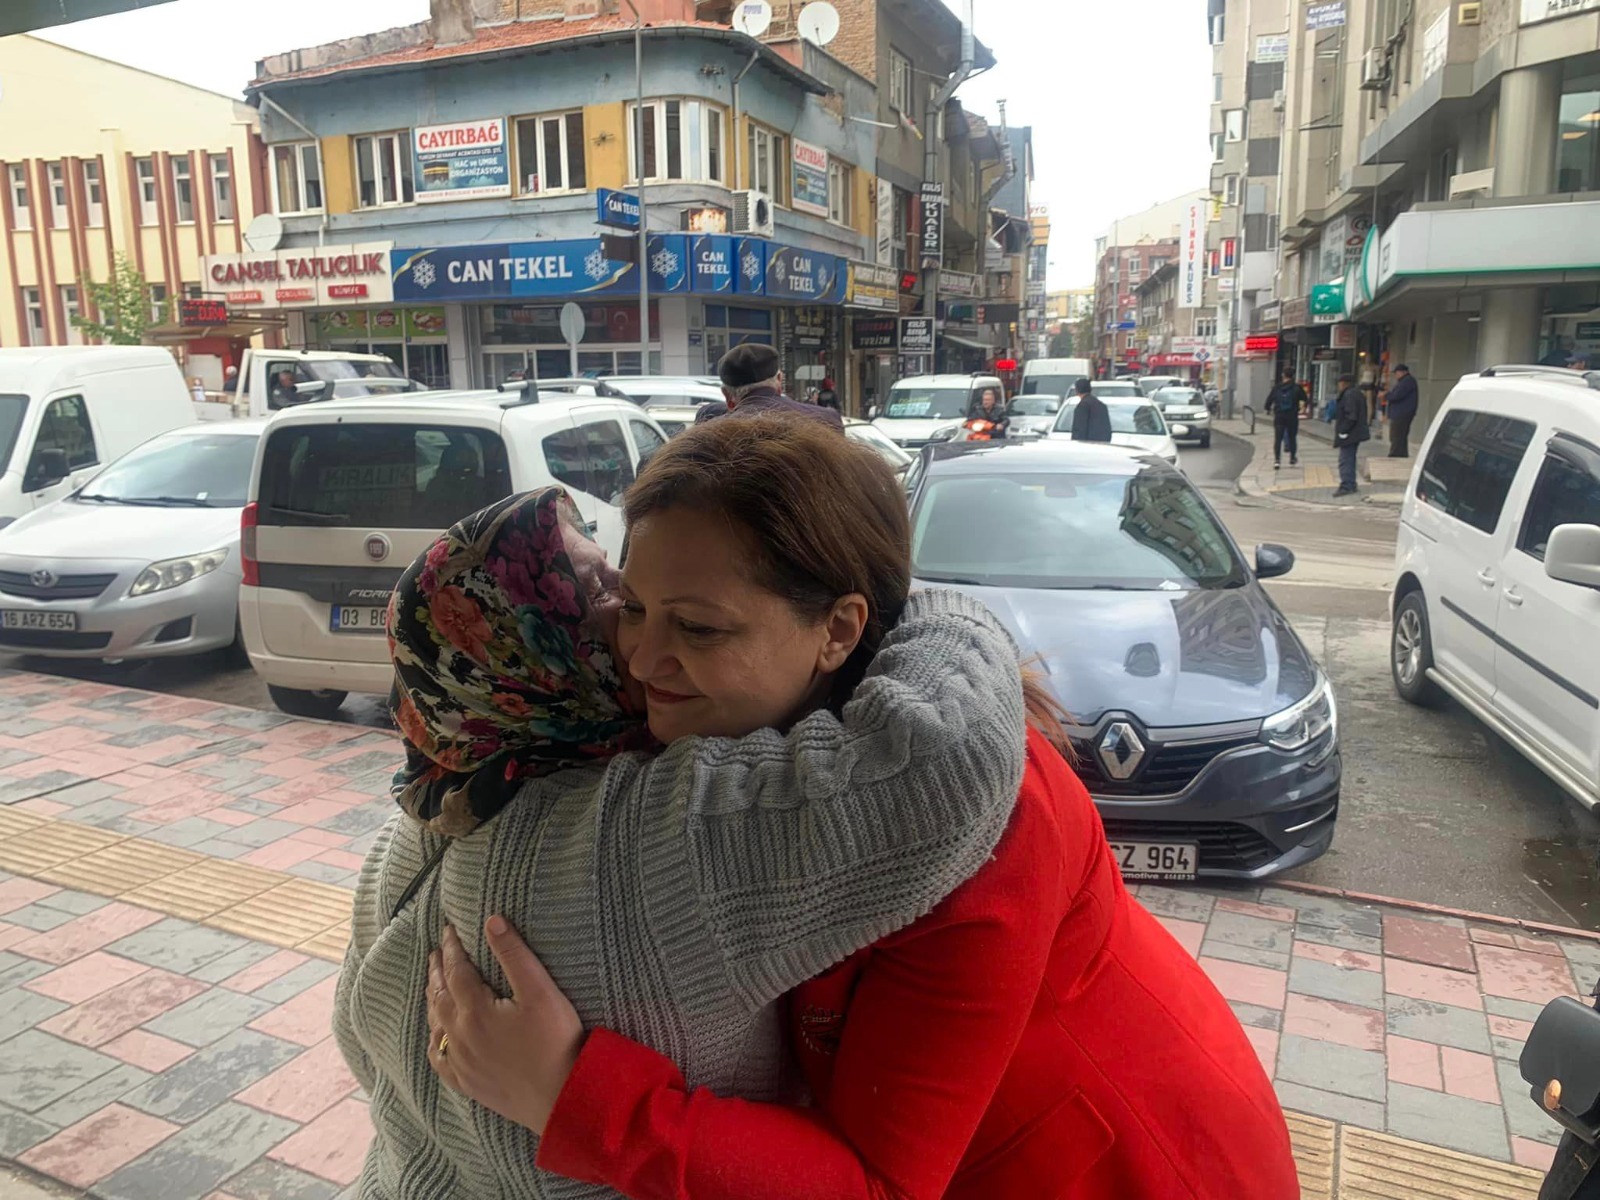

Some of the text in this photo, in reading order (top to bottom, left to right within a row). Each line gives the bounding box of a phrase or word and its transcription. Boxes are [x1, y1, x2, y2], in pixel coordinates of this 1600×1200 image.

[418, 122, 500, 150] ÇAYIRBAĞ
[609, 199, 623, 214] CAN
[1188, 206, 1197, 261] SINAV
[702, 251, 724, 262] CAN
[793, 256, 812, 273] CAN
[212, 252, 385, 283] CANSEL TATLICILIK
[447, 255, 573, 283] CAN TEKEL
[697, 264, 730, 275] TEKEL
[788, 275, 816, 293] TEKEL
[1186, 261, 1195, 304] KURS
[342, 608, 360, 627] 03
[1147, 846, 1190, 870] 964
